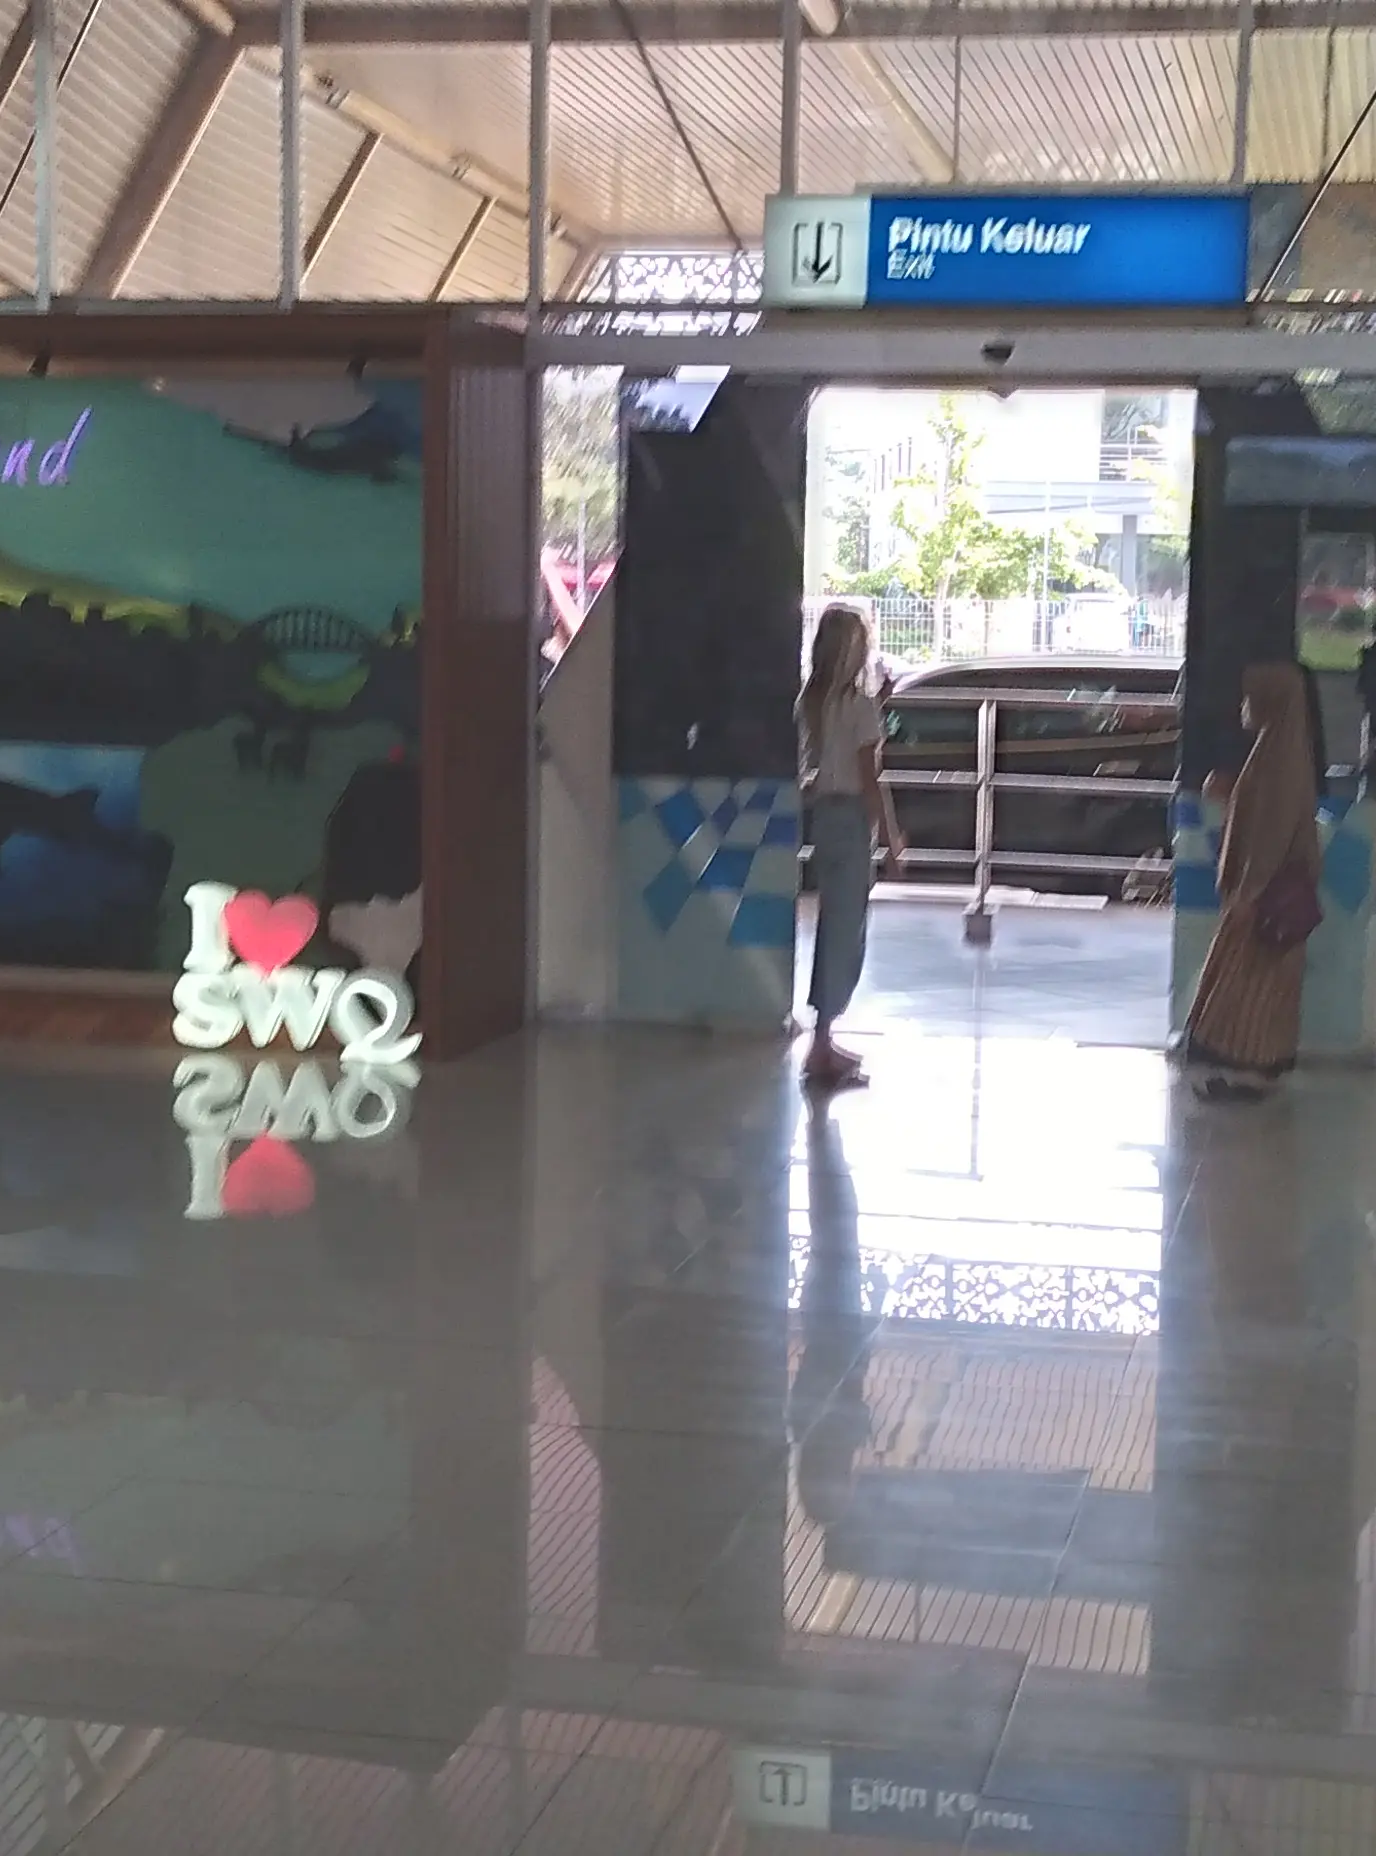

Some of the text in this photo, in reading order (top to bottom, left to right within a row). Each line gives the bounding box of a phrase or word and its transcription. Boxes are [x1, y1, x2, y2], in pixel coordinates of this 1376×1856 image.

[887, 249, 936, 280] Exit
[888, 216, 1092, 255] Pintu Keluar
[183, 880, 238, 971] I
[173, 963, 423, 1065] SWQ
